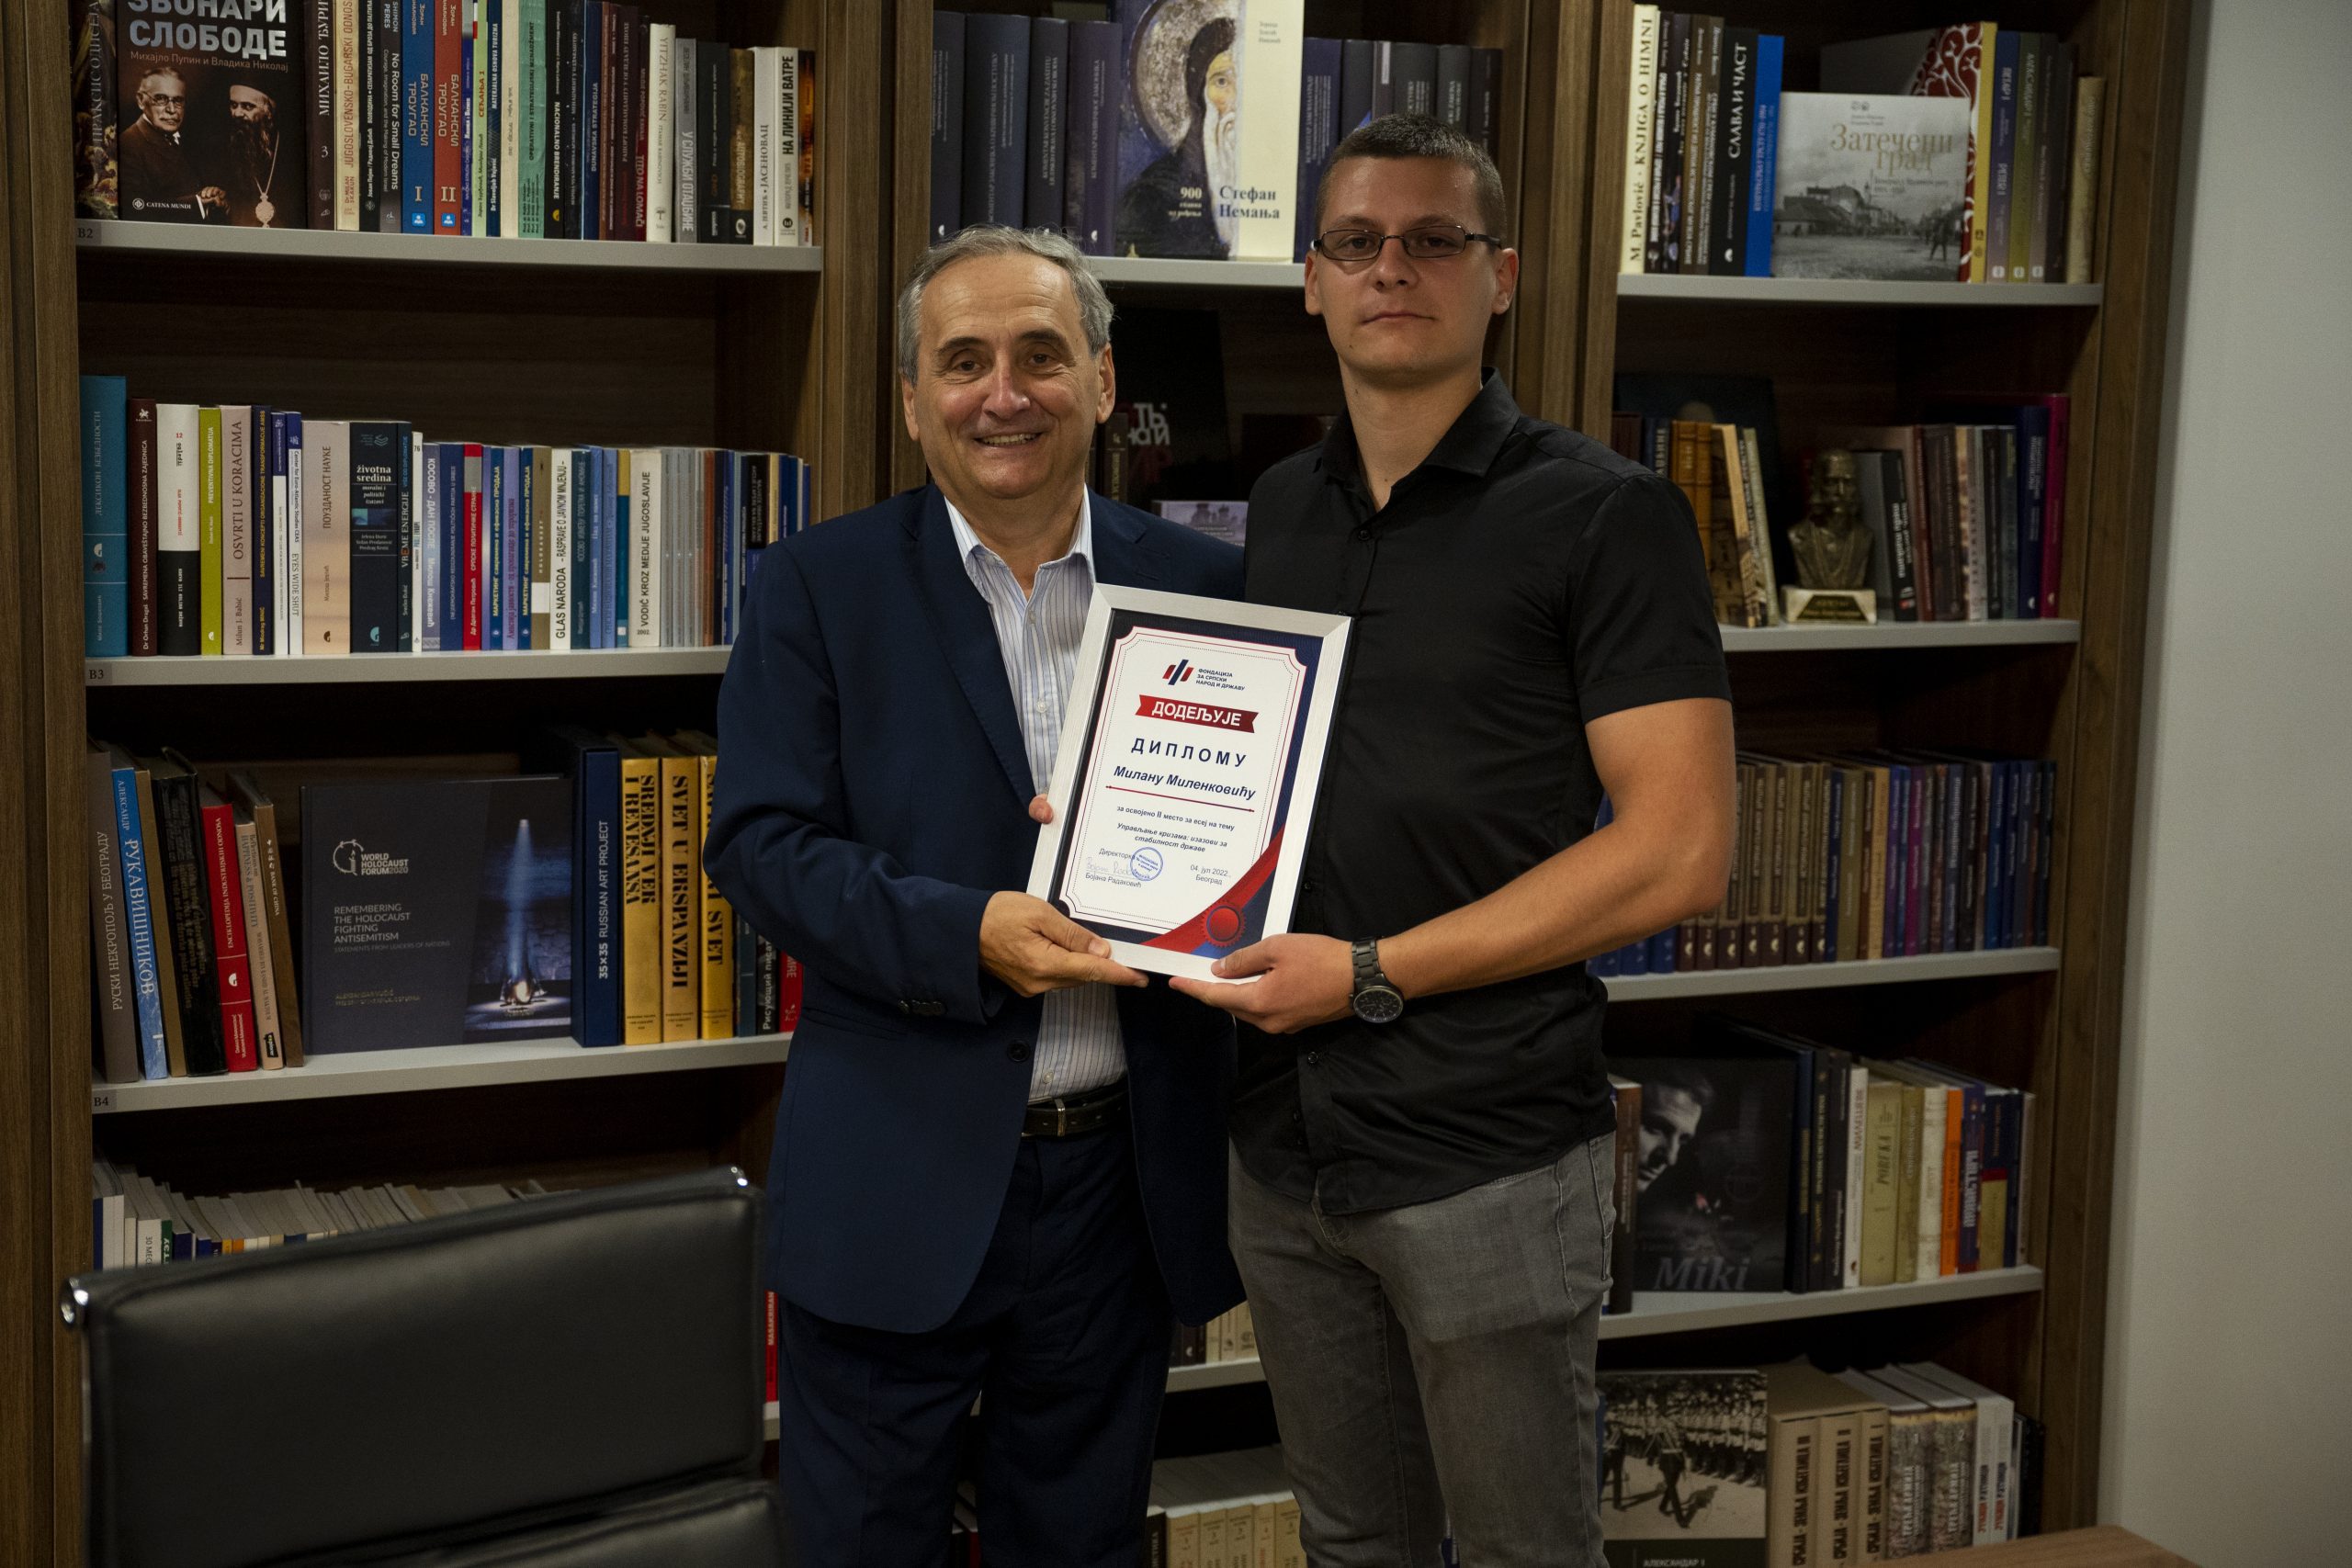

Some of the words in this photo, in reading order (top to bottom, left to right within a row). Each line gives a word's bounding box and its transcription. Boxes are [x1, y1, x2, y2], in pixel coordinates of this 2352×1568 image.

[130, 19, 287, 60] СЛОБОДЕ
[1640, 18, 1652, 75] HIMNI
[130, 51, 169, 64] Михајло
[171, 54, 200, 66] Пупин
[211, 58, 251, 68] Владика
[253, 61, 288, 73] Николај
[391, 53, 400, 67] No
[659, 37, 669, 86] YITZHAK
[783, 56, 794, 89] ВАТРЕ
[1733, 42, 1747, 87] ЧАСТ
[391, 70, 400, 100] Room
[1639, 84, 1648, 96] O
[391, 103, 400, 118] for
[408, 82, 416, 136] ТРОУГАО
[438, 83, 447, 137] ТРОУГАО
[450, 74, 458, 146] БАЛКАНСКИ
[659, 89, 667, 121] RABIN
[783, 93, 794, 138] ЛИНИЈИ
[391, 121, 400, 148] Small
[1635, 105, 1648, 164] KNJIGA
[1728, 102, 1744, 158] СЛАВА
[1831, 123, 1953, 154] Затечени
[321, 146, 329, 157] 3
[682, 138, 693, 181] СЛУЖБИ
[760, 125, 769, 187] ЈАСЕНОВАЦ
[783, 141, 794, 154] НА
[391, 151, 400, 189] Dreams
[635, 154, 644, 175] TITO
[636, 178, 643, 190] NA
[1180, 186, 1202, 199] 900
[1219, 186, 1276, 204] Стефан
[635, 191, 643, 227] LOMAČI
[681, 183, 693, 232] ОТАЏБИНЕ
[1219, 205, 1280, 219] Немања
[1631, 183, 1644, 239] Pavlović
[78, 228, 93, 239] B2
[94, 411, 102, 468] БЕЗБЕДНОСТИ
[232, 421, 243, 493] KORACIMA
[322, 446, 331, 473] НАУКЕ
[356, 465, 391, 473] životna
[356, 474, 391, 482] sredina
[557, 466, 566, 492] MNJENJU
[232, 497, 243, 508] U
[322, 475, 333, 528] ПОУЗДАНОСТ
[401, 492, 409, 533] ENERGIJE
[426, 500, 435, 518] ДАН
[557, 494, 566, 518] JAVNOM
[232, 513, 243, 559] OSVRTI
[426, 520, 435, 548] ПОСЛЕ
[556, 526, 566, 557] RASPRAVE
[401, 535, 409, 568] VREME
[556, 568, 566, 609] NARODA
[141, 604, 151, 622] Dragaš
[234, 598, 243, 616] Babić
[639, 599, 649, 626] VODIČ
[556, 613, 566, 638] GLAS
[89, 670, 103, 679] B3
[1198, 669, 1233, 677] ФОНДАЦИЈА
[1152, 701, 1241, 726] ДОДЕЉУЈЕ
[1131, 738, 1246, 767] ДИПЛОМУ
[1114, 765, 1163, 785] Милану
[1167, 774, 1256, 800] Миленковићу
[673, 775, 688, 828] SVET
[641, 774, 656, 859] SREDNJI
[1125, 807, 1156, 818] освојено
[1163, 814, 1183, 822] место
[1193, 818, 1207, 827] есеј
[1218, 823, 1235, 831] тему
[626, 793, 640, 905] RENESANSA
[673, 840, 688, 854] U
[1117, 823, 1158, 835] Управљање
[1159, 829, 1189, 840] кризама:
[1191, 835, 1218, 846] изазови
[1135, 835, 1179, 848] стабилност
[1181, 841, 1205, 852] државе
[96, 831, 112, 890] БЕОГРАДУ
[361, 859, 409, 868] HOLOCAUST
[118, 780, 130, 830] АЛЕКСАНДР
[124, 839, 154, 994] РУКАВИШНИКОВ
[641, 863, 656, 905] VEK
[1196, 874, 1223, 886] Београд
[334, 904, 401, 915] REMEMBERING
[334, 915, 353, 924] THE
[355, 912, 411, 923] HOLOCAUST
[104, 903, 120, 971] НЕКРОПОЉ
[334, 924, 379, 933] FIGHTING
[334, 932, 399, 944] ANTISEMITISM
[673, 864, 688, 987] EKSPANZIJI
[707, 911, 723, 964] SVET
[109, 974, 123, 1010] РУСКИ
[94, 1097, 110, 1106] B4
[1655, 1257, 1751, 1292] Miki
[1959, 1431, 1965, 1441] 2
